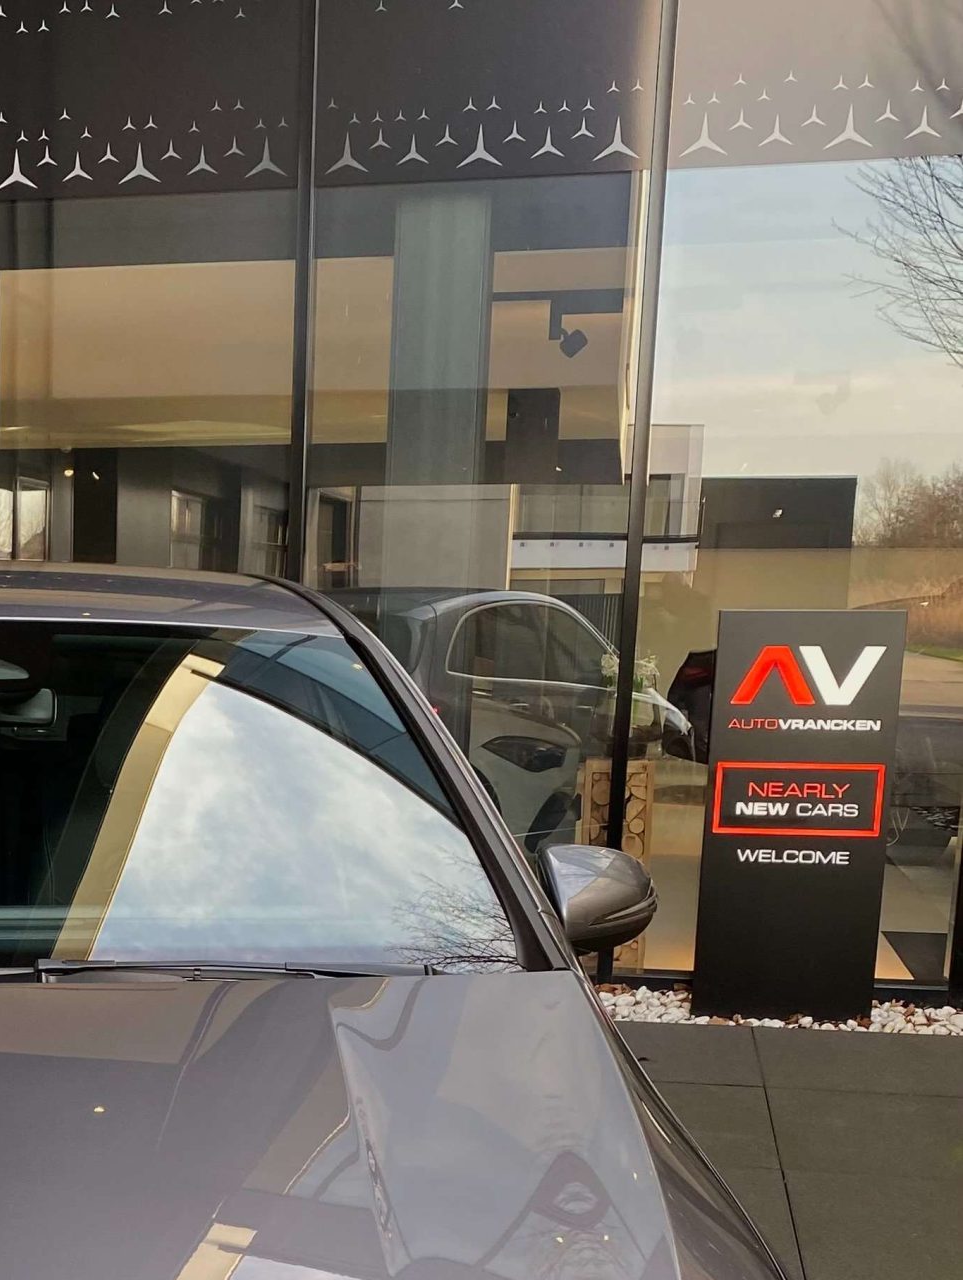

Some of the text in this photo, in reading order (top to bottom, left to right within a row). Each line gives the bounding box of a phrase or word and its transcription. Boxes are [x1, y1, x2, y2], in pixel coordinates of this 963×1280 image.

[730, 645, 888, 706] AV
[748, 782, 850, 798] NEARLY
[735, 802, 859, 817] NEW CARS
[737, 849, 850, 865] WELCOME
